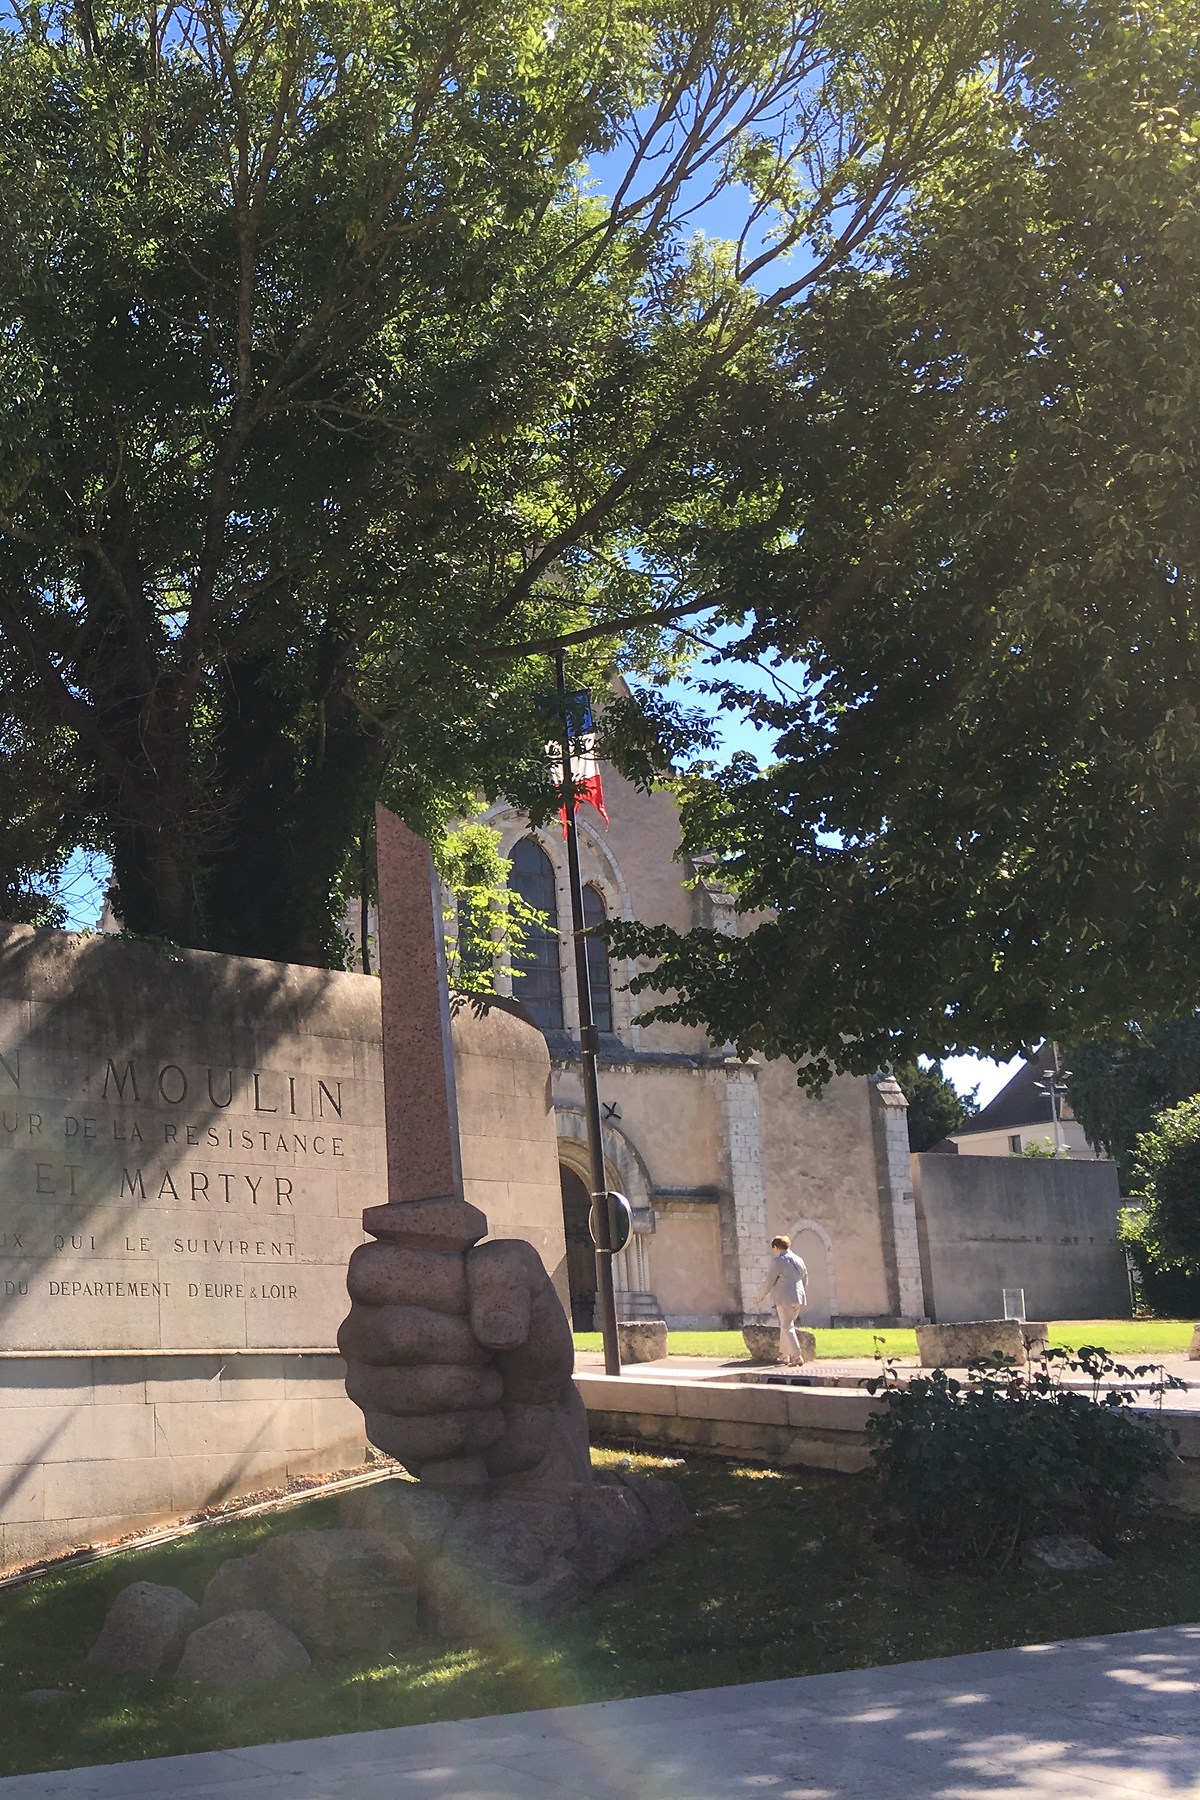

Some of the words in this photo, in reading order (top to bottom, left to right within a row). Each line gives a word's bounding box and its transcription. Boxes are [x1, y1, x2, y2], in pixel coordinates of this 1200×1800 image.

[101, 1058, 342, 1118] MOULIN
[64, 1115, 97, 1140] DE
[113, 1119, 143, 1143] LA
[163, 1123, 345, 1157] RESISTANCE
[35, 1163, 82, 1198] ET
[119, 1168, 294, 1206] MARTYR
[53, 1234, 97, 1251] QUI
[125, 1236, 150, 1252] LE
[173, 1238, 296, 1256] SUIVIRENT
[5, 1280, 29, 1297] DU
[49, 1281, 170, 1298] DEPARTEMENT
[261, 1285, 298, 1300] LOIR
